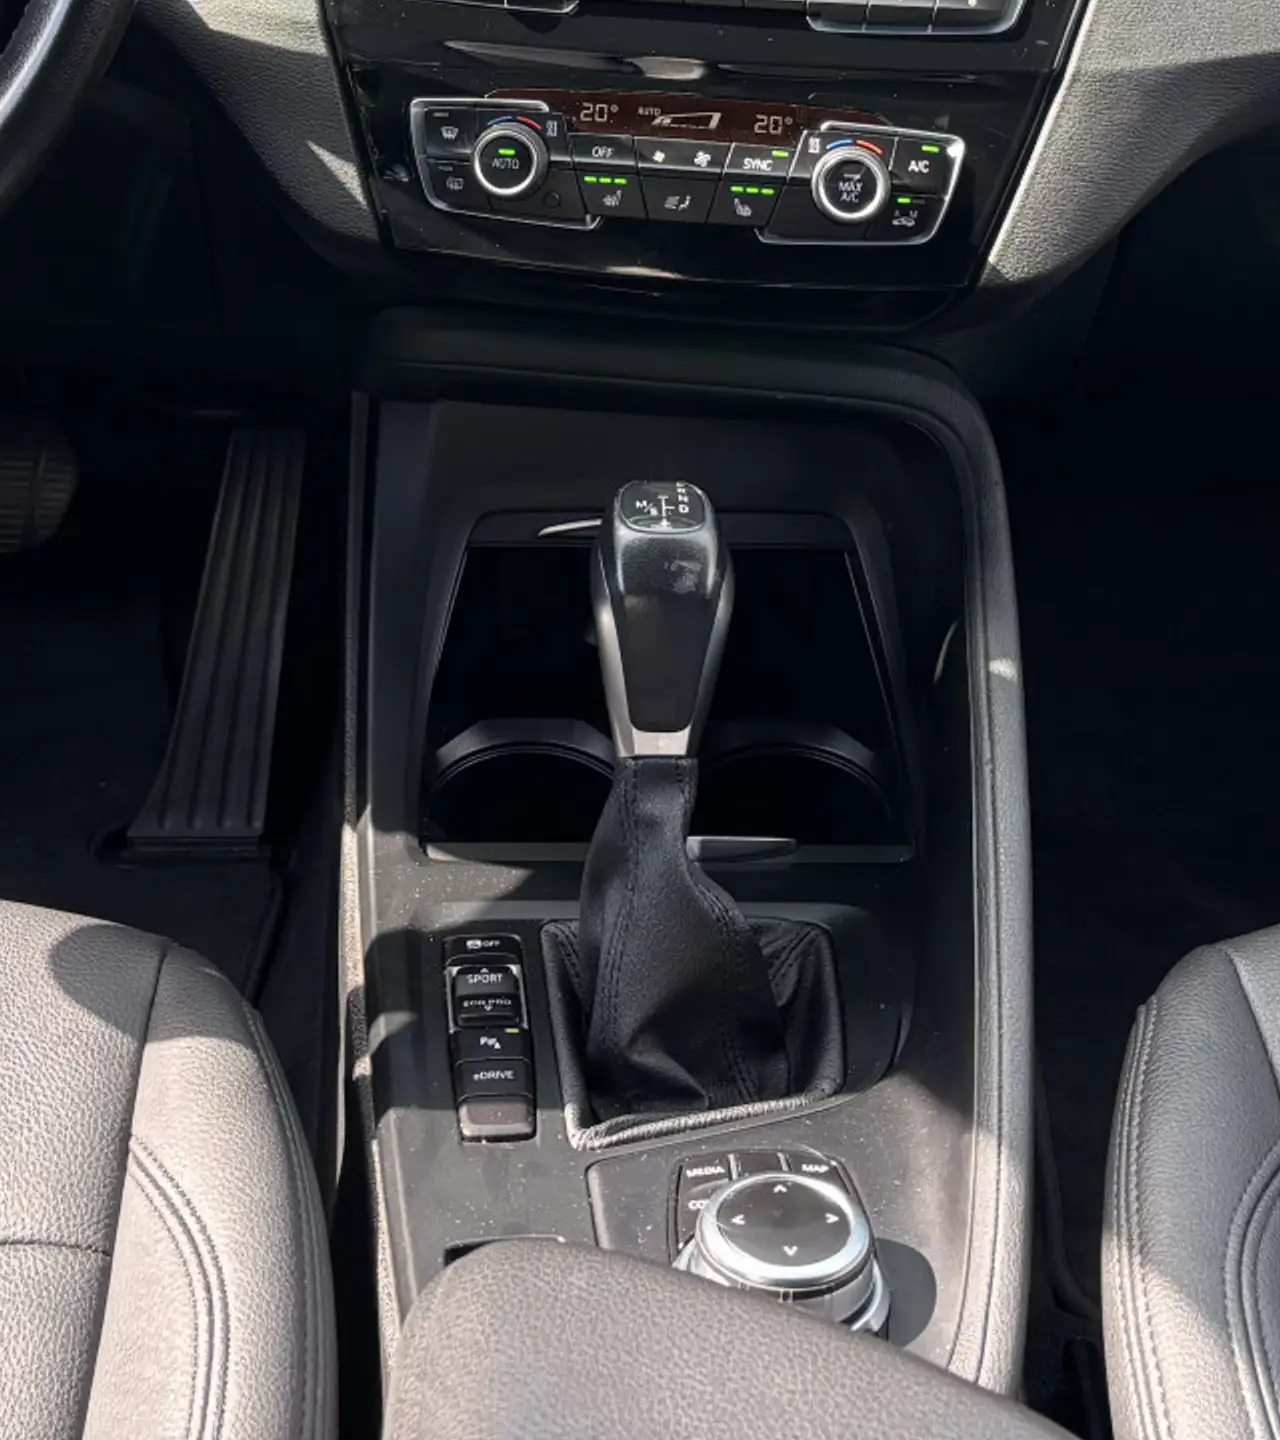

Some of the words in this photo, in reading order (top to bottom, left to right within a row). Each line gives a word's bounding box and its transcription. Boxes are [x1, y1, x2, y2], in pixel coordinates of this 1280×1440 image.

[592, 146, 614, 158] OFF
[491, 158, 520, 170] AUTO
[742, 158, 773, 172] SYNC
[908, 160, 930, 174] A/C
[838, 181, 863, 193] MAX
[840, 192, 859, 203] A/C
[678, 504, 690, 514] D
[466, 973, 503, 984] SPORT
[473, 1070, 515, 1082] eDRIVE
[686, 1165, 726, 1178] MEDIA
[801, 1163, 829, 1173] MAP
